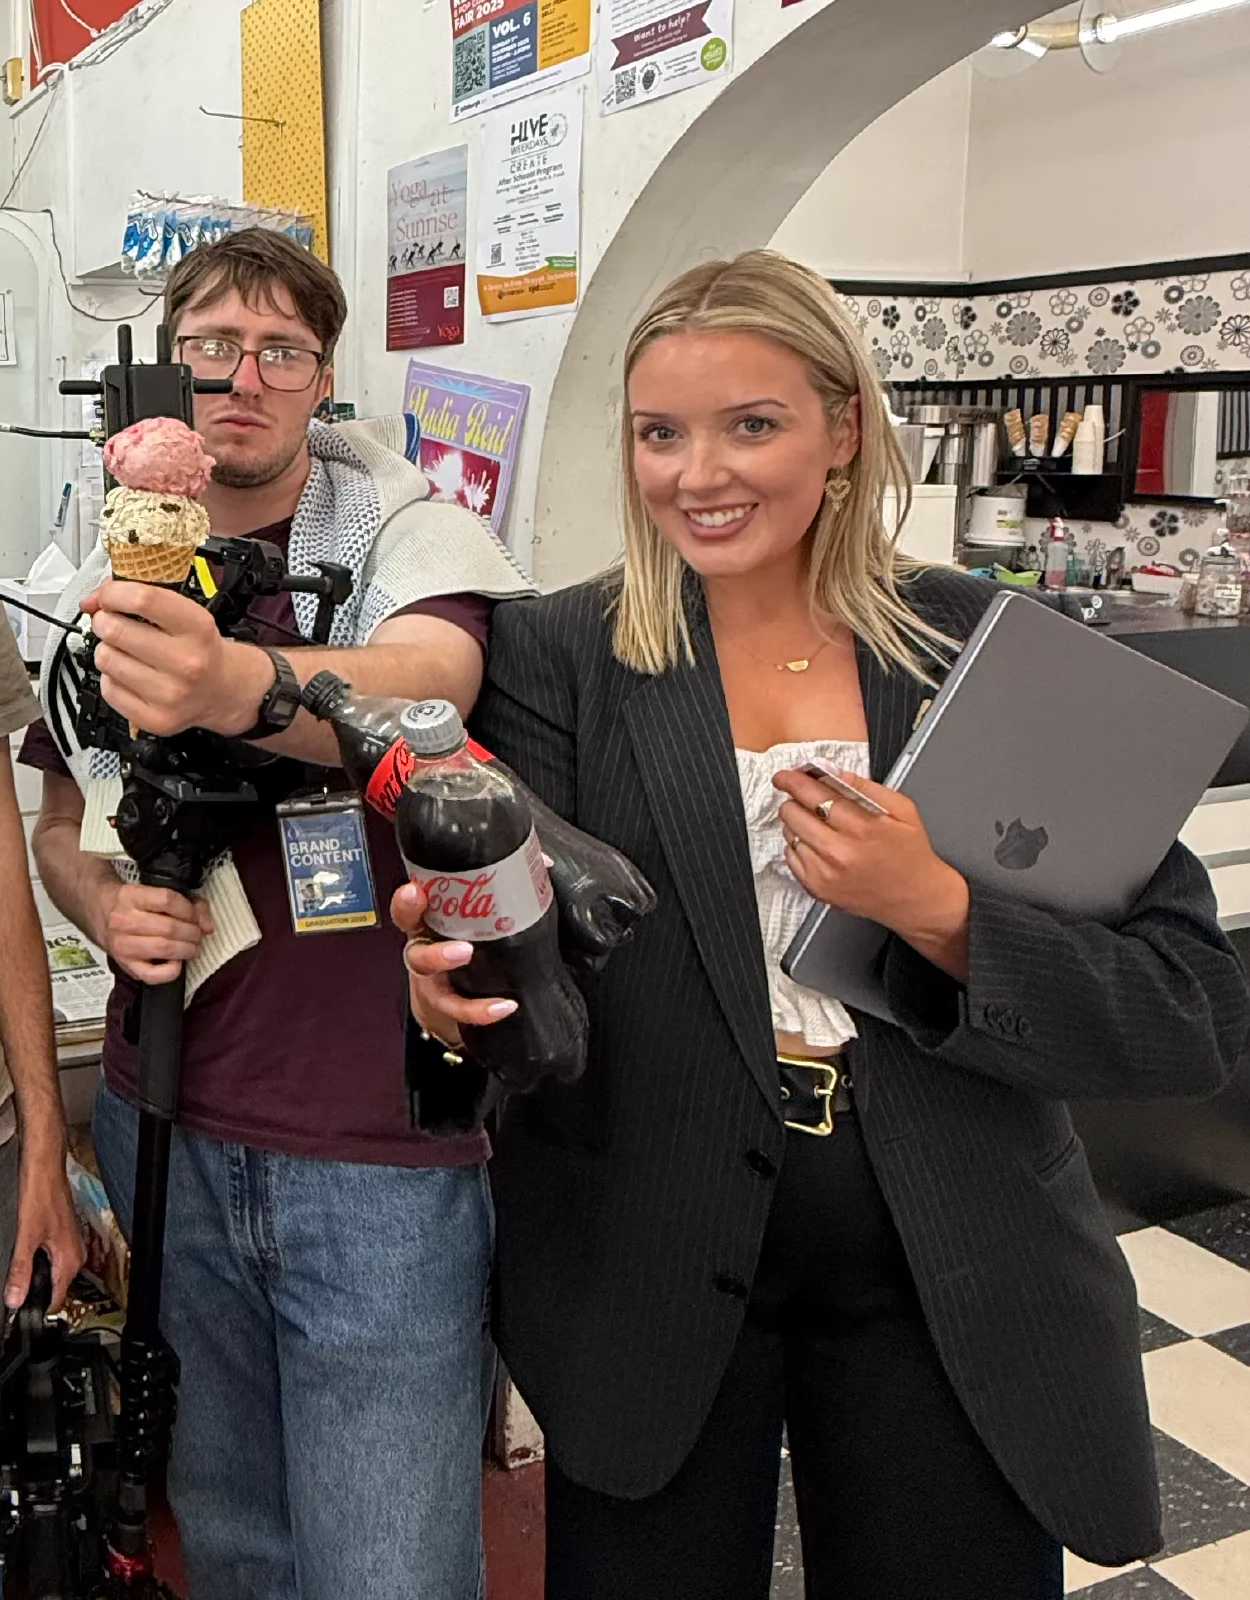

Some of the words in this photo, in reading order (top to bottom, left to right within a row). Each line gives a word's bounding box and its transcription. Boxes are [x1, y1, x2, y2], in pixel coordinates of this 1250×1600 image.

[454, 10, 474, 32] FAIR
[476, 0, 505, 19] 2025
[492, 18, 520, 39] VOL.
[523, 11, 531, 27] 6
[633, 26, 655, 42] Want
[658, 22, 666, 32] to
[668, 12, 691, 29] help?
[511, 113, 548, 146] HIVE
[510, 136, 549, 155] WEEKDAYS
[510, 154, 547, 174] CREATE
[536, 163, 563, 176] Program
[391, 179, 427, 209] Yoga
[432, 184, 451, 207] at
[396, 208, 459, 243] Sunrise
[437, 325, 460, 340] Yoga
[289, 838, 340, 855] BRAND
[290, 848, 363, 867] CONTENT
[423, 868, 498, 919] Cola
[305, 917, 350, 928] GRADUATION
[71, 970, 106, 980] woes
